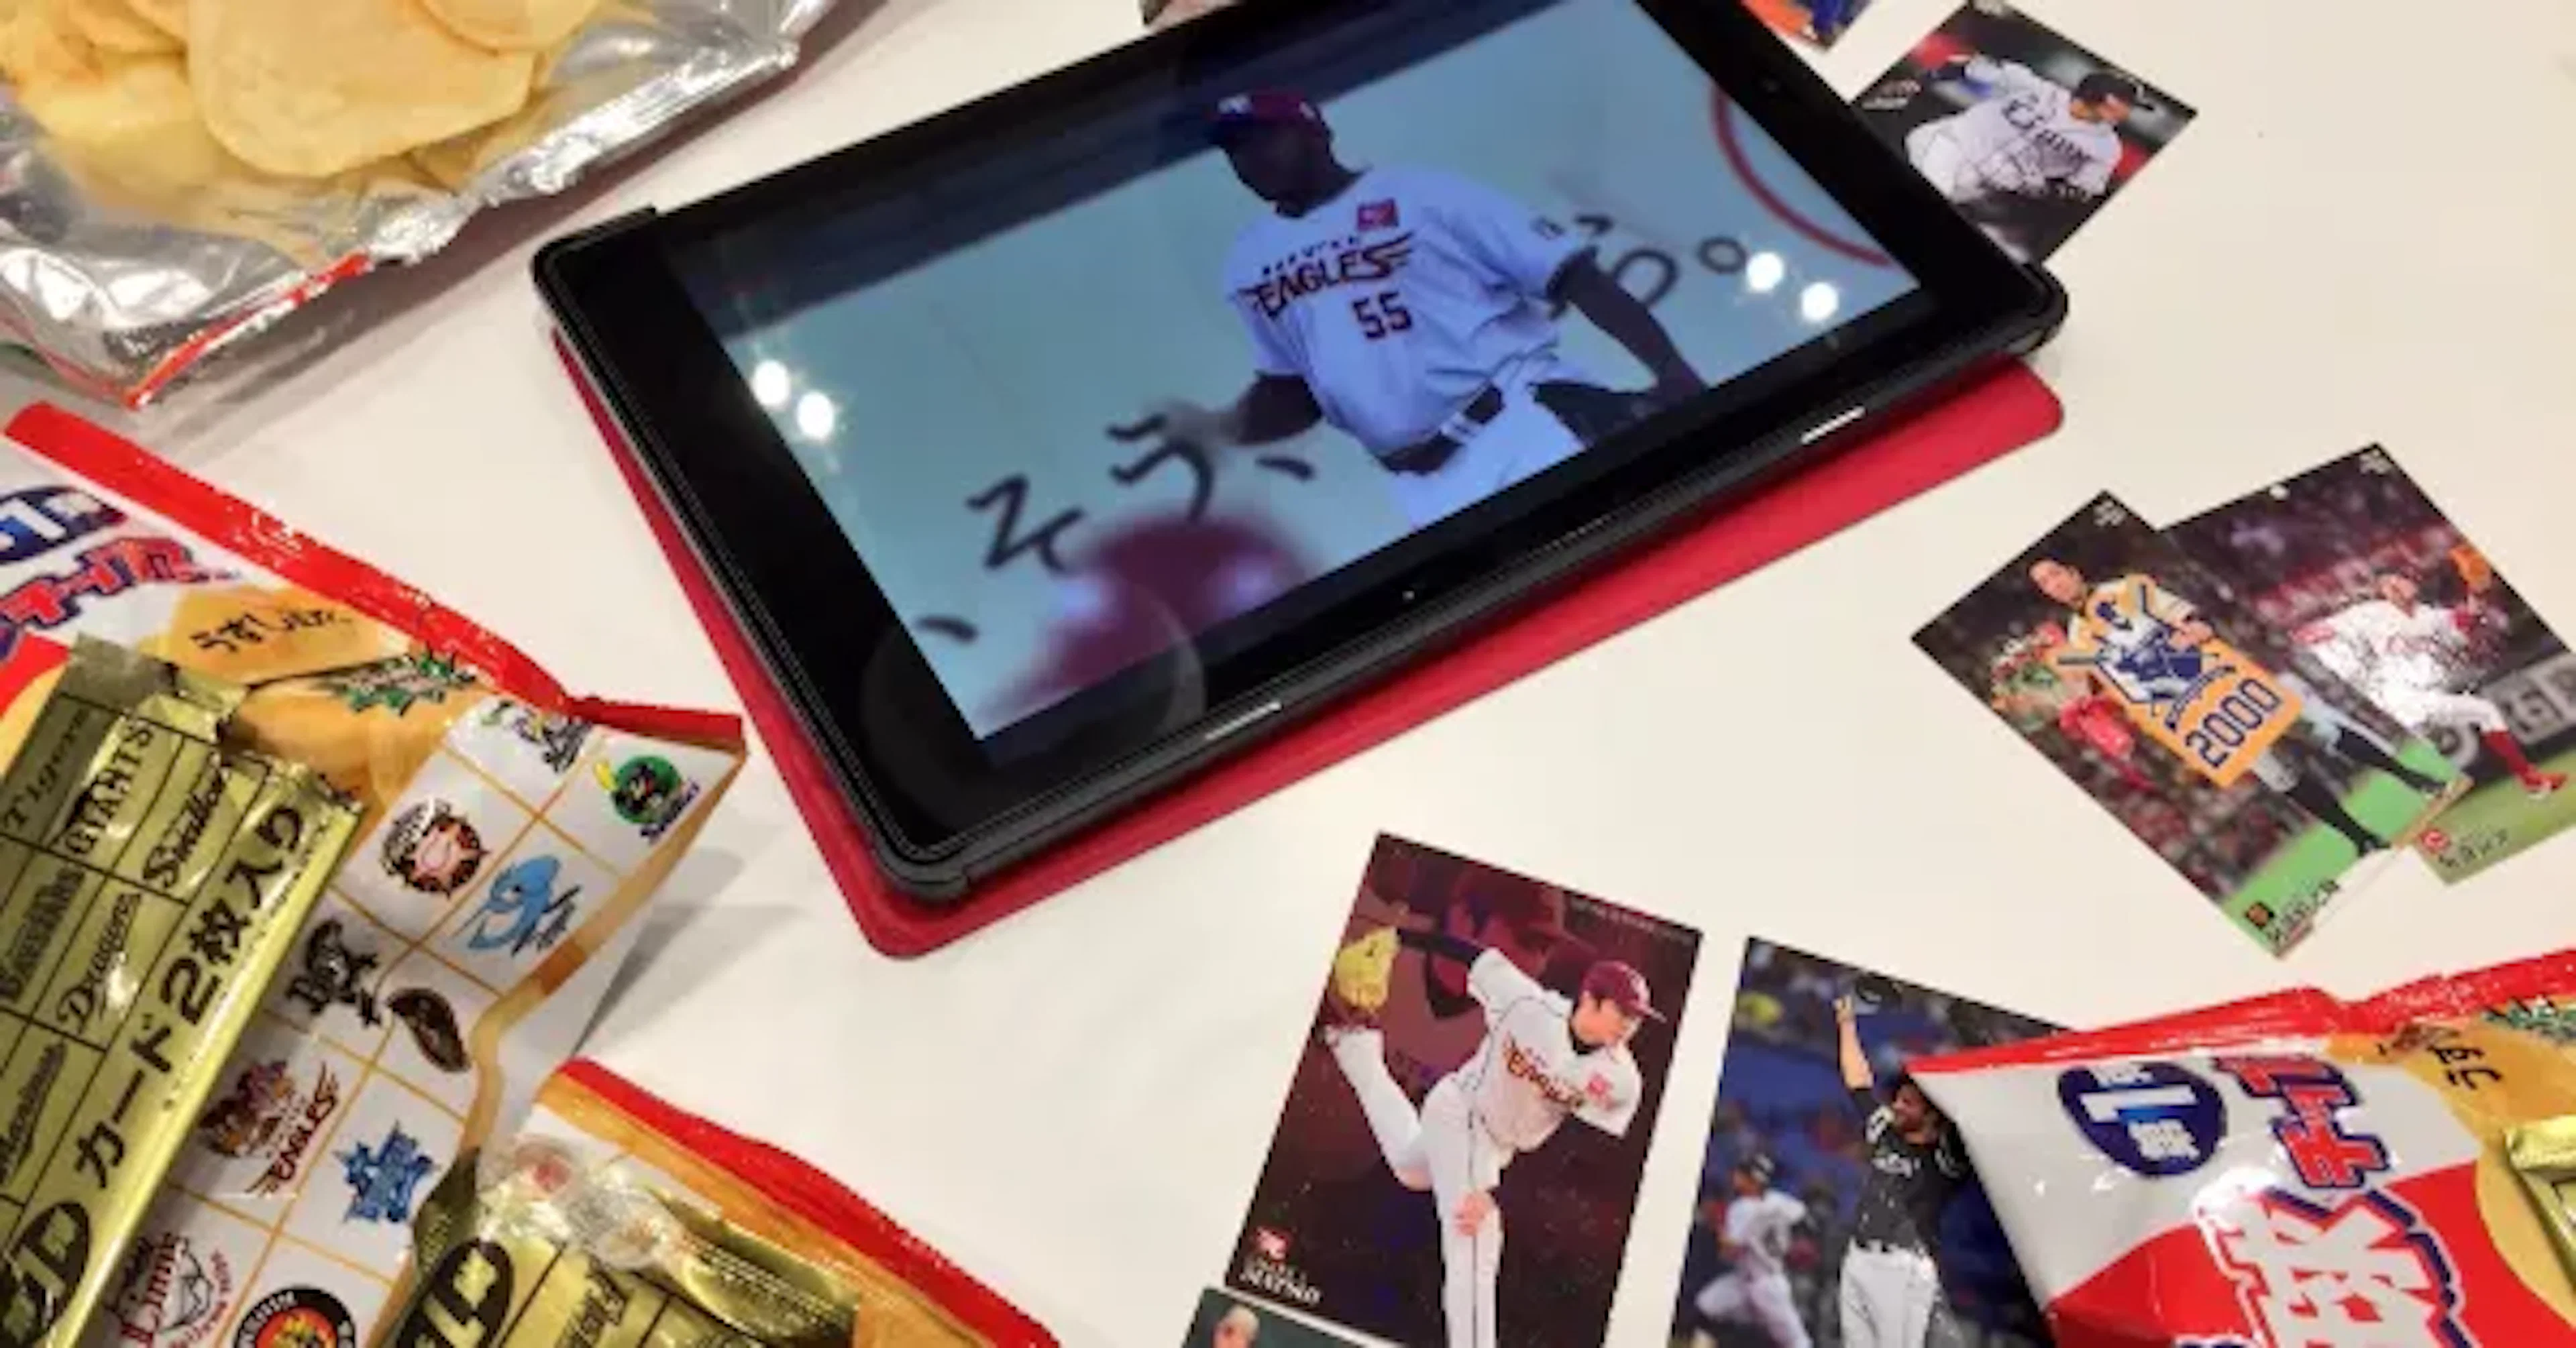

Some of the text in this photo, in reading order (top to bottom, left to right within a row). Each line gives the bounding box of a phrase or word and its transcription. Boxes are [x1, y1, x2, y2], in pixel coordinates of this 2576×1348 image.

[1238, 232, 1413, 319] EAGLES
[1351, 291, 1413, 341] 55
[2186, 677, 2281, 769] 2000
[67, 722, 155, 854] GIANTS
[73, 807, 303, 1190] カード2枚入り
